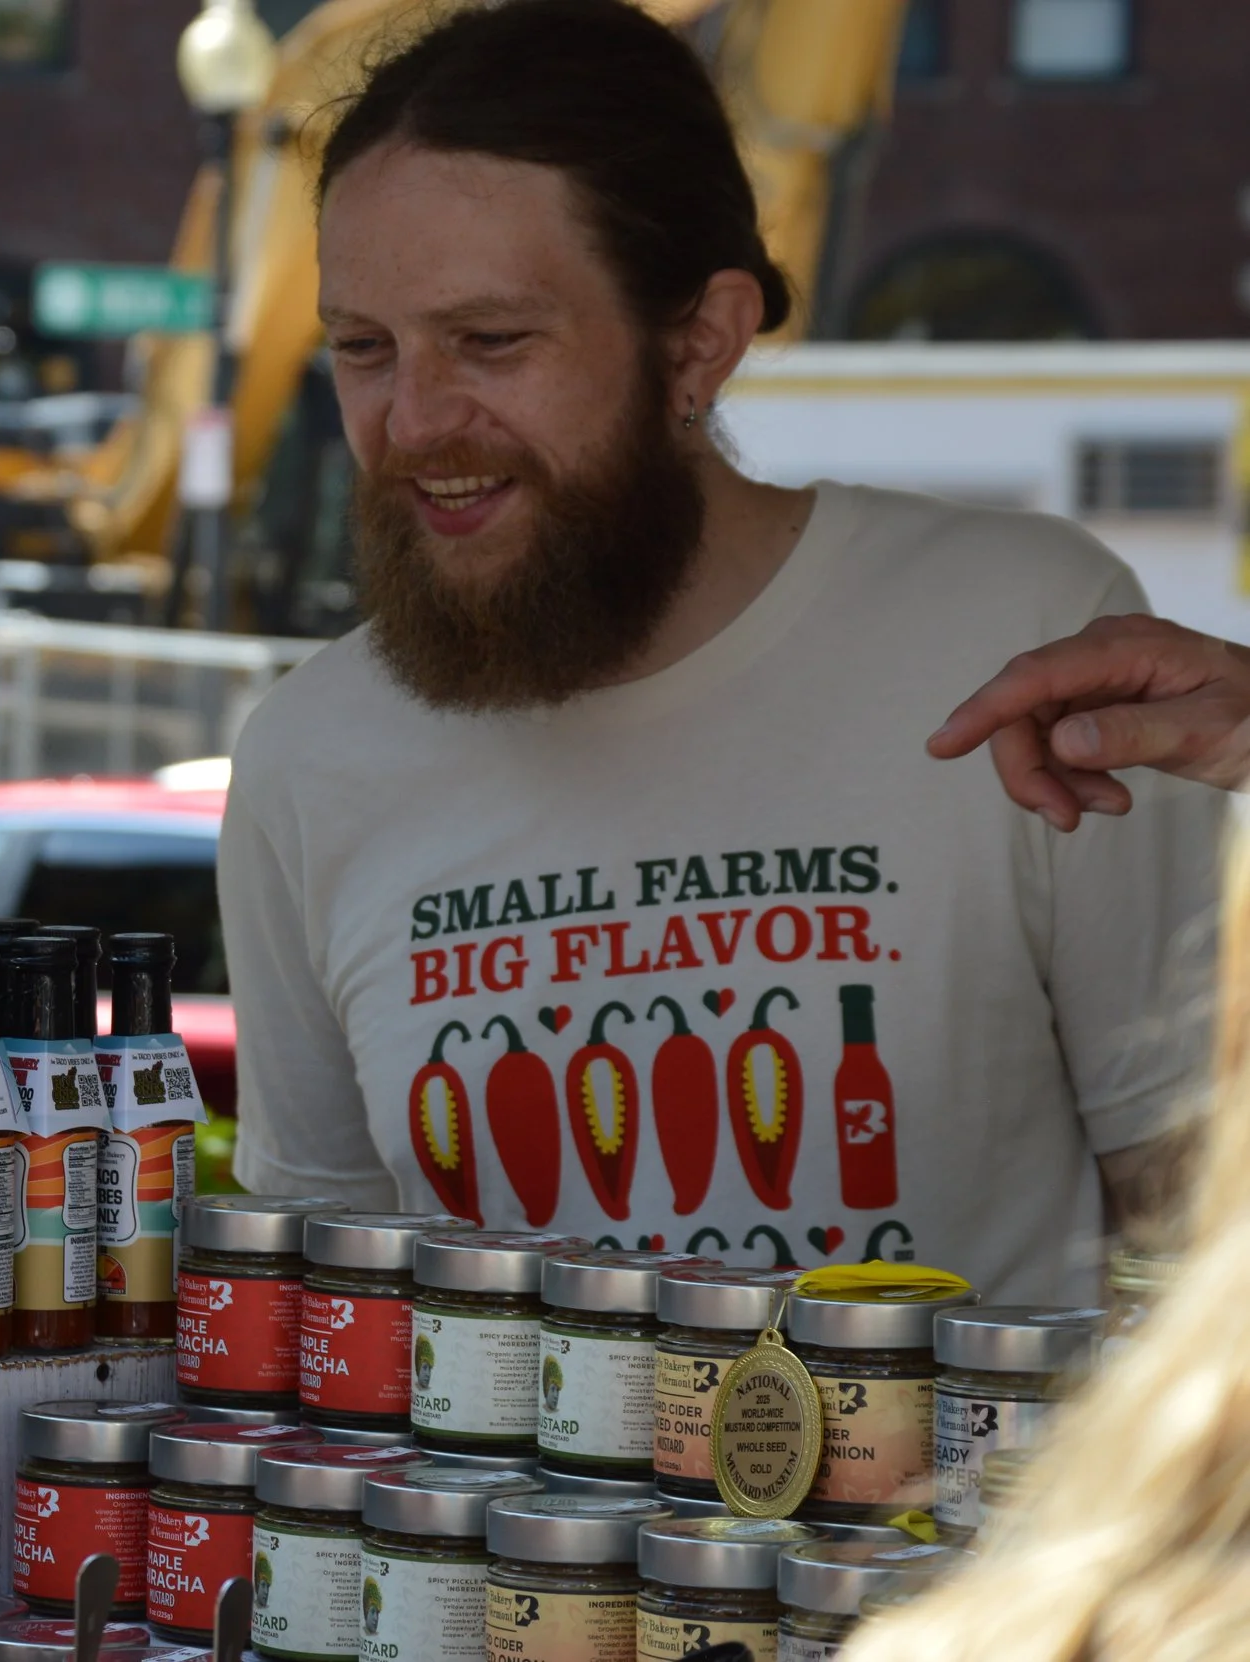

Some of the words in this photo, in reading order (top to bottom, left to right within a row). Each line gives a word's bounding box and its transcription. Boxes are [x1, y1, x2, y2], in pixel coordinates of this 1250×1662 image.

[411, 867, 615, 942] SMALL
[636, 845, 899, 908] FARMS.
[410, 934, 530, 1006] BIG
[550, 905, 901, 983] FLAVOR.
[97, 1170, 119, 1186] ACO
[97, 1210, 119, 1225] NLY
[185, 1279, 208, 1295] Bakery
[183, 1292, 208, 1306] Vermont
[308, 1296, 330, 1314] Bakery
[300, 1351, 350, 1376] RACHA
[664, 1359, 691, 1378] Bakery
[301, 1372, 322, 1389] USTARD
[662, 1374, 692, 1389] Vermont
[736, 1375, 791, 1401] NATIONAL
[756, 1395, 771, 1404] 2025
[818, 1385, 835, 1399] ery
[412, 1393, 451, 1412] STARD
[943, 1401, 969, 1420] Bakery
[669, 1404, 703, 1419] CIDER
[742, 1408, 784, 1418] WORLD-WIDE
[540, 1415, 579, 1435] STARD
[656, 1416, 671, 1432] KED
[725, 1422, 756, 1432] MUSTARD
[757, 1422, 800, 1432] COMPETITION
[941, 1417, 970, 1433] Vermont
[657, 1436, 685, 1455] MUSTARD
[736, 1442, 764, 1453] WHOLE
[766, 1442, 787, 1452] SEED
[726, 1452, 762, 1500] MUSTARD
[762, 1450, 799, 1500] MUSEUM
[750, 1464, 772, 1474] GOLD
[935, 1462, 981, 1489] PPER
[941, 1489, 962, 1505] STARD
[158, 1512, 183, 1532] Bakery
[14, 1525, 37, 1542] APLE
[155, 1526, 183, 1542] Vermont
[14, 1560, 31, 1577] STARD
[490, 1590, 513, 1610] Bakery
[157, 1610, 174, 1621] (225g)
[252, 1612, 288, 1631] STARD
[489, 1608, 513, 1621] ermont
[650, 1620, 680, 1640] Bakery
[361, 1638, 399, 1659] STARD
[494, 1640, 524, 1653] CIDER
[647, 1634, 681, 1652] Vermont
